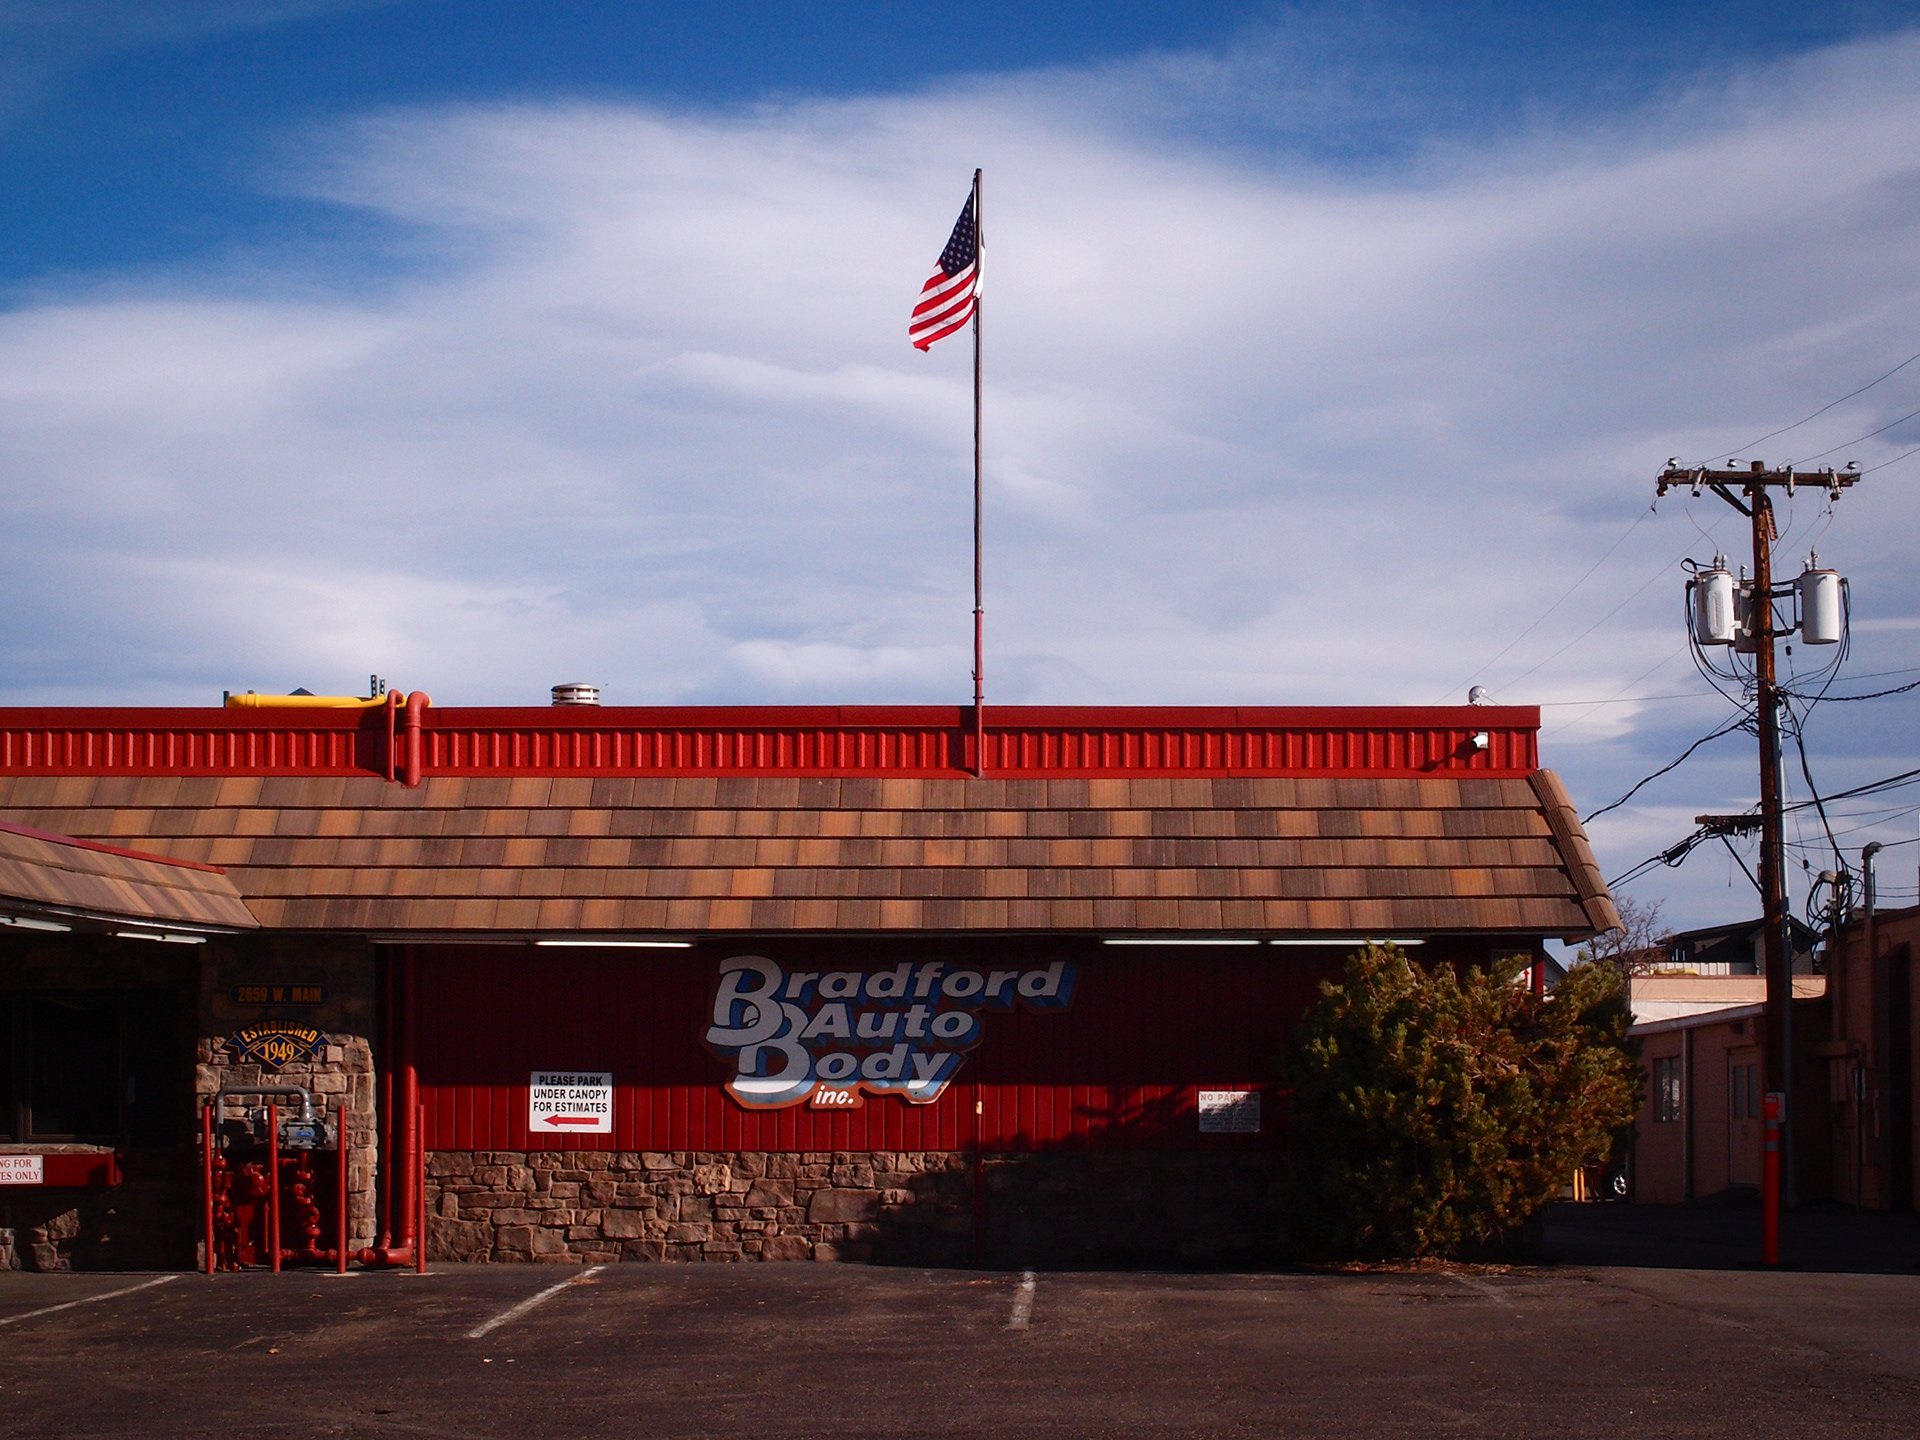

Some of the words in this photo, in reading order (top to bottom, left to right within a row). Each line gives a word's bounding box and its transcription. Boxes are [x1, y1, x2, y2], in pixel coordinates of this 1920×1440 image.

[238, 987, 268, 1002] 2659
[272, 987, 286, 1002] W.
[291, 987, 322, 1002] MAIN
[705, 955, 1065, 1046] Bradford
[799, 1002, 974, 1039] Auto
[240, 1020, 318, 1043] ESTABLISHED
[263, 1041, 295, 1061] 1949
[539, 1076, 574, 1086] PLEASE
[577, 1076, 603, 1086] PARK
[534, 1089, 566, 1099] UNDER
[568, 1089, 607, 1099] CANOPY
[815, 1085, 854, 1105] inc.
[533, 1102, 552, 1112] FOR
[555, 1102, 607, 1112] ESTIMATES
[14, 1159, 32, 1168] FOR
[15, 1171, 39, 1180] ONLY
